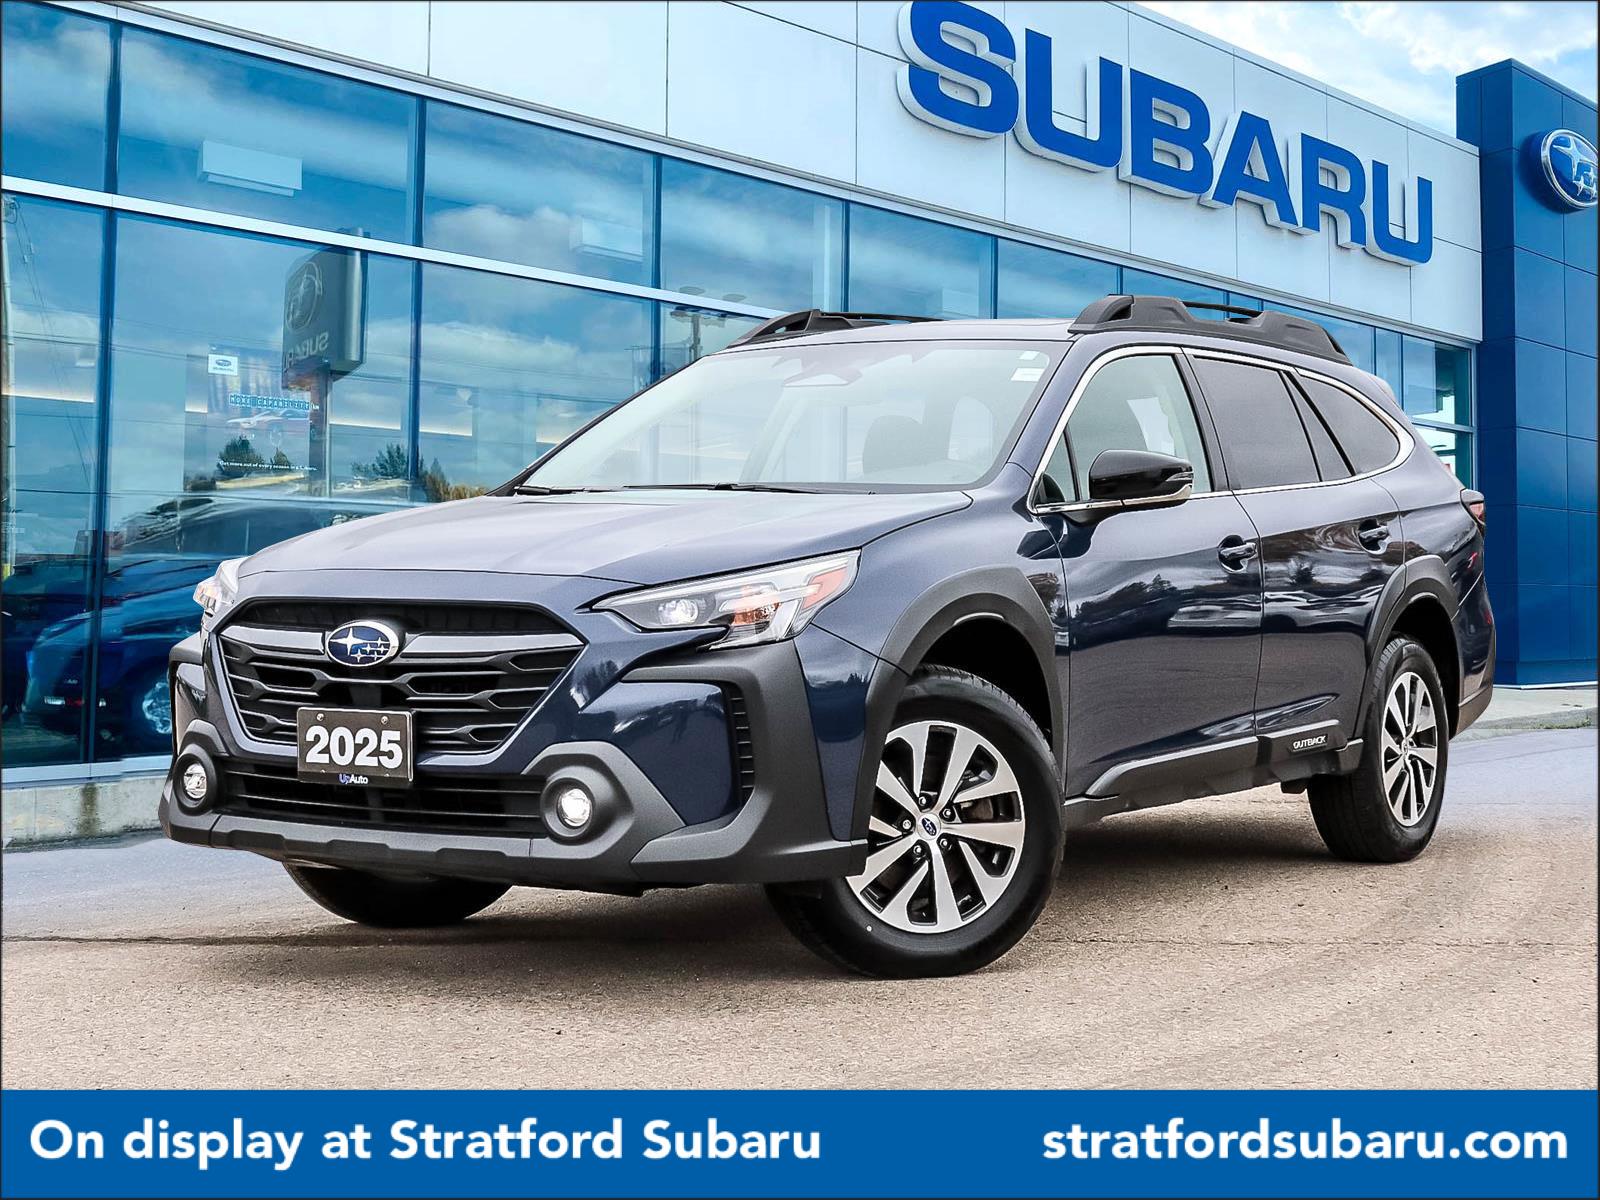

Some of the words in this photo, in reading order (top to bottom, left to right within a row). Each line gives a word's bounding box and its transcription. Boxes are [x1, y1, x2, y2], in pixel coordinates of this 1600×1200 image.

[900, 0, 1433, 265] SUBARU
[305, 725, 403, 769] 2025
[1293, 735, 1327, 750] OUTBACK
[339, 773, 369, 785] UpAuto
